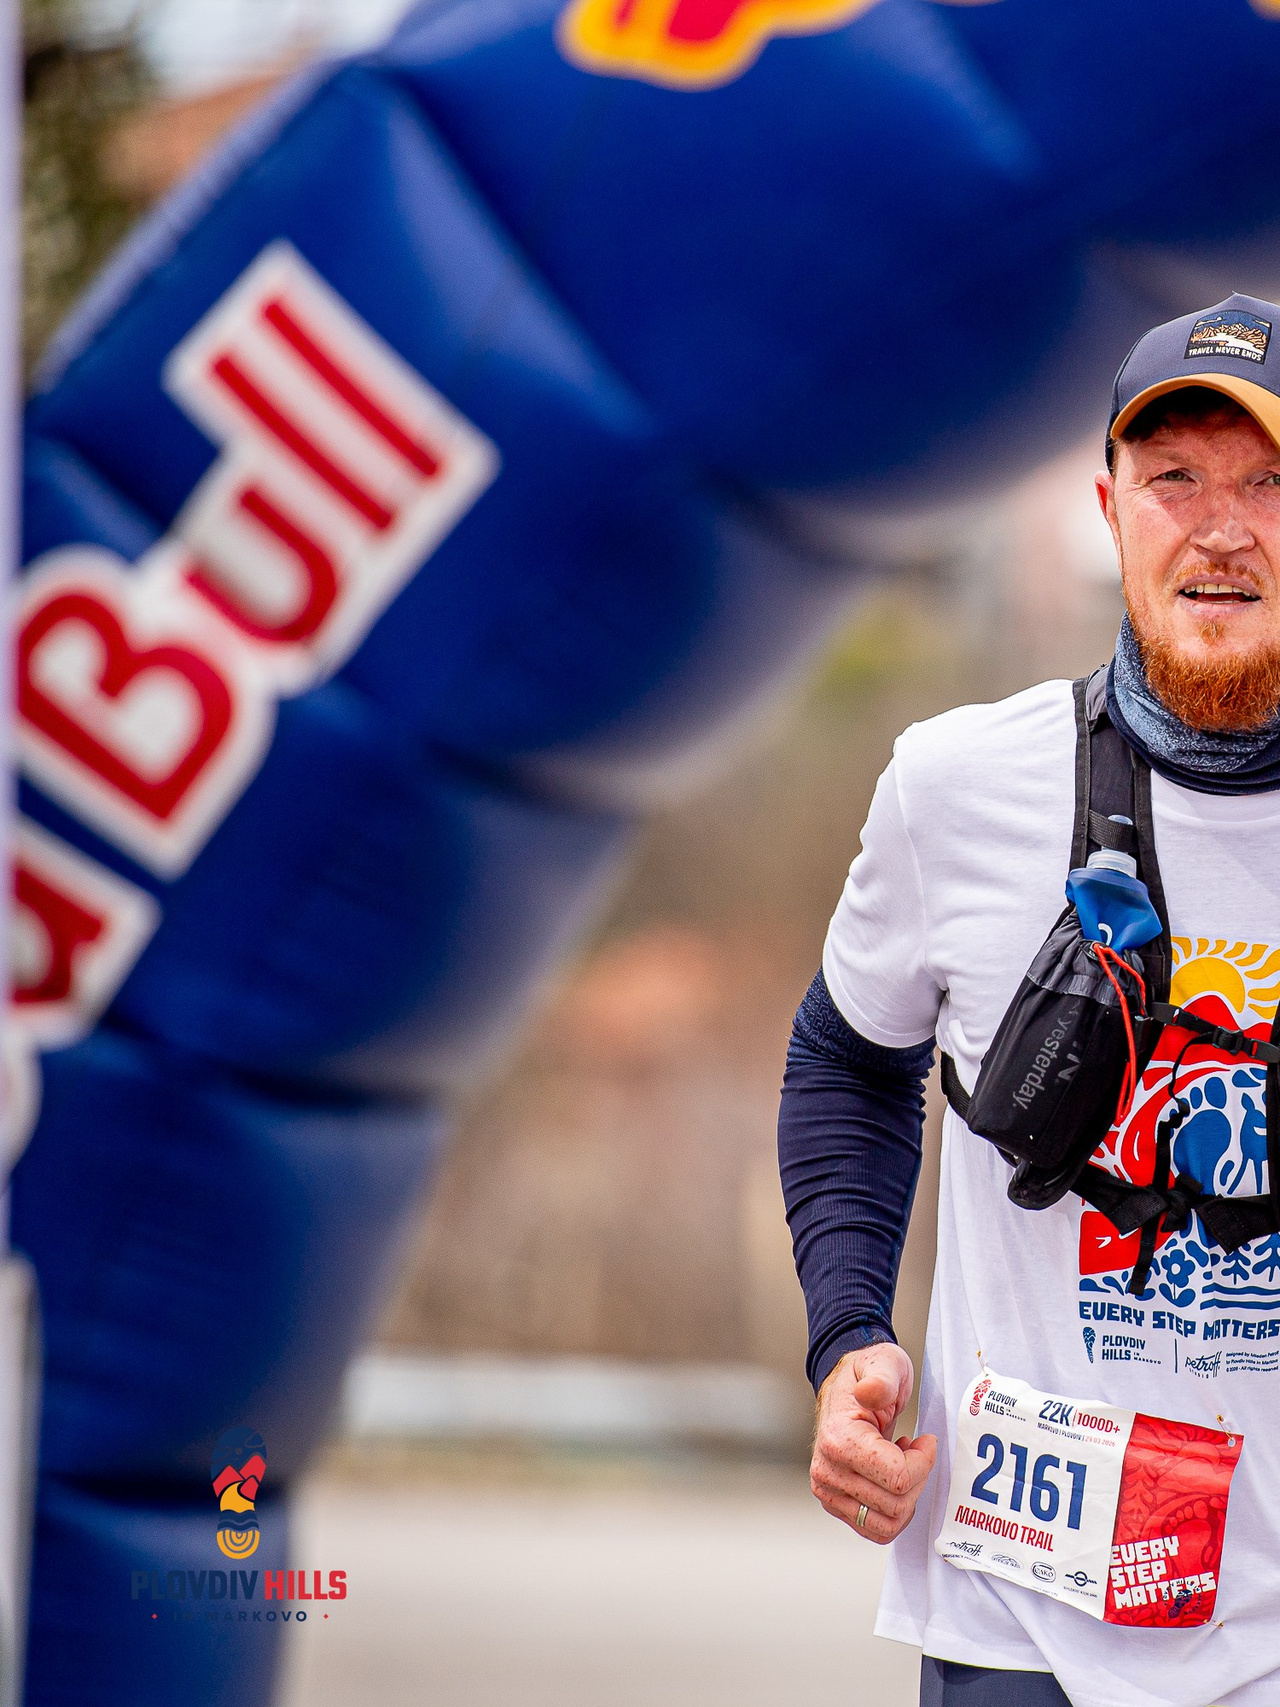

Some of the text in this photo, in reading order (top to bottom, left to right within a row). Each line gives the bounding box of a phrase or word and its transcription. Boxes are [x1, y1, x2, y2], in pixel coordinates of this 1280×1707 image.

[1188, 346, 1262, 361] TRAVEL NEVER ENDS
[14, 294, 443, 823] Bull
[1079, 1301, 1280, 1341] EVERY STEP MATTERS
[1102, 1335, 1146, 1350] PLOVDIV
[1102, 1348, 1131, 1361] HILLS
[984, 1401, 1005, 1416] HILLS
[988, 1390, 1017, 1407] PLOVDIV
[1038, 1399, 1075, 1427] 22K
[1077, 1412, 1121, 1434] 1000D+
[970, 1433, 1087, 1531] 2161
[954, 1504, 1054, 1552] MARKOVO TRAIL
[1109, 1535, 1179, 1566] EVERY
[1110, 1559, 1167, 1588] STEP
[1113, 1571, 1217, 1610] MATTERS
